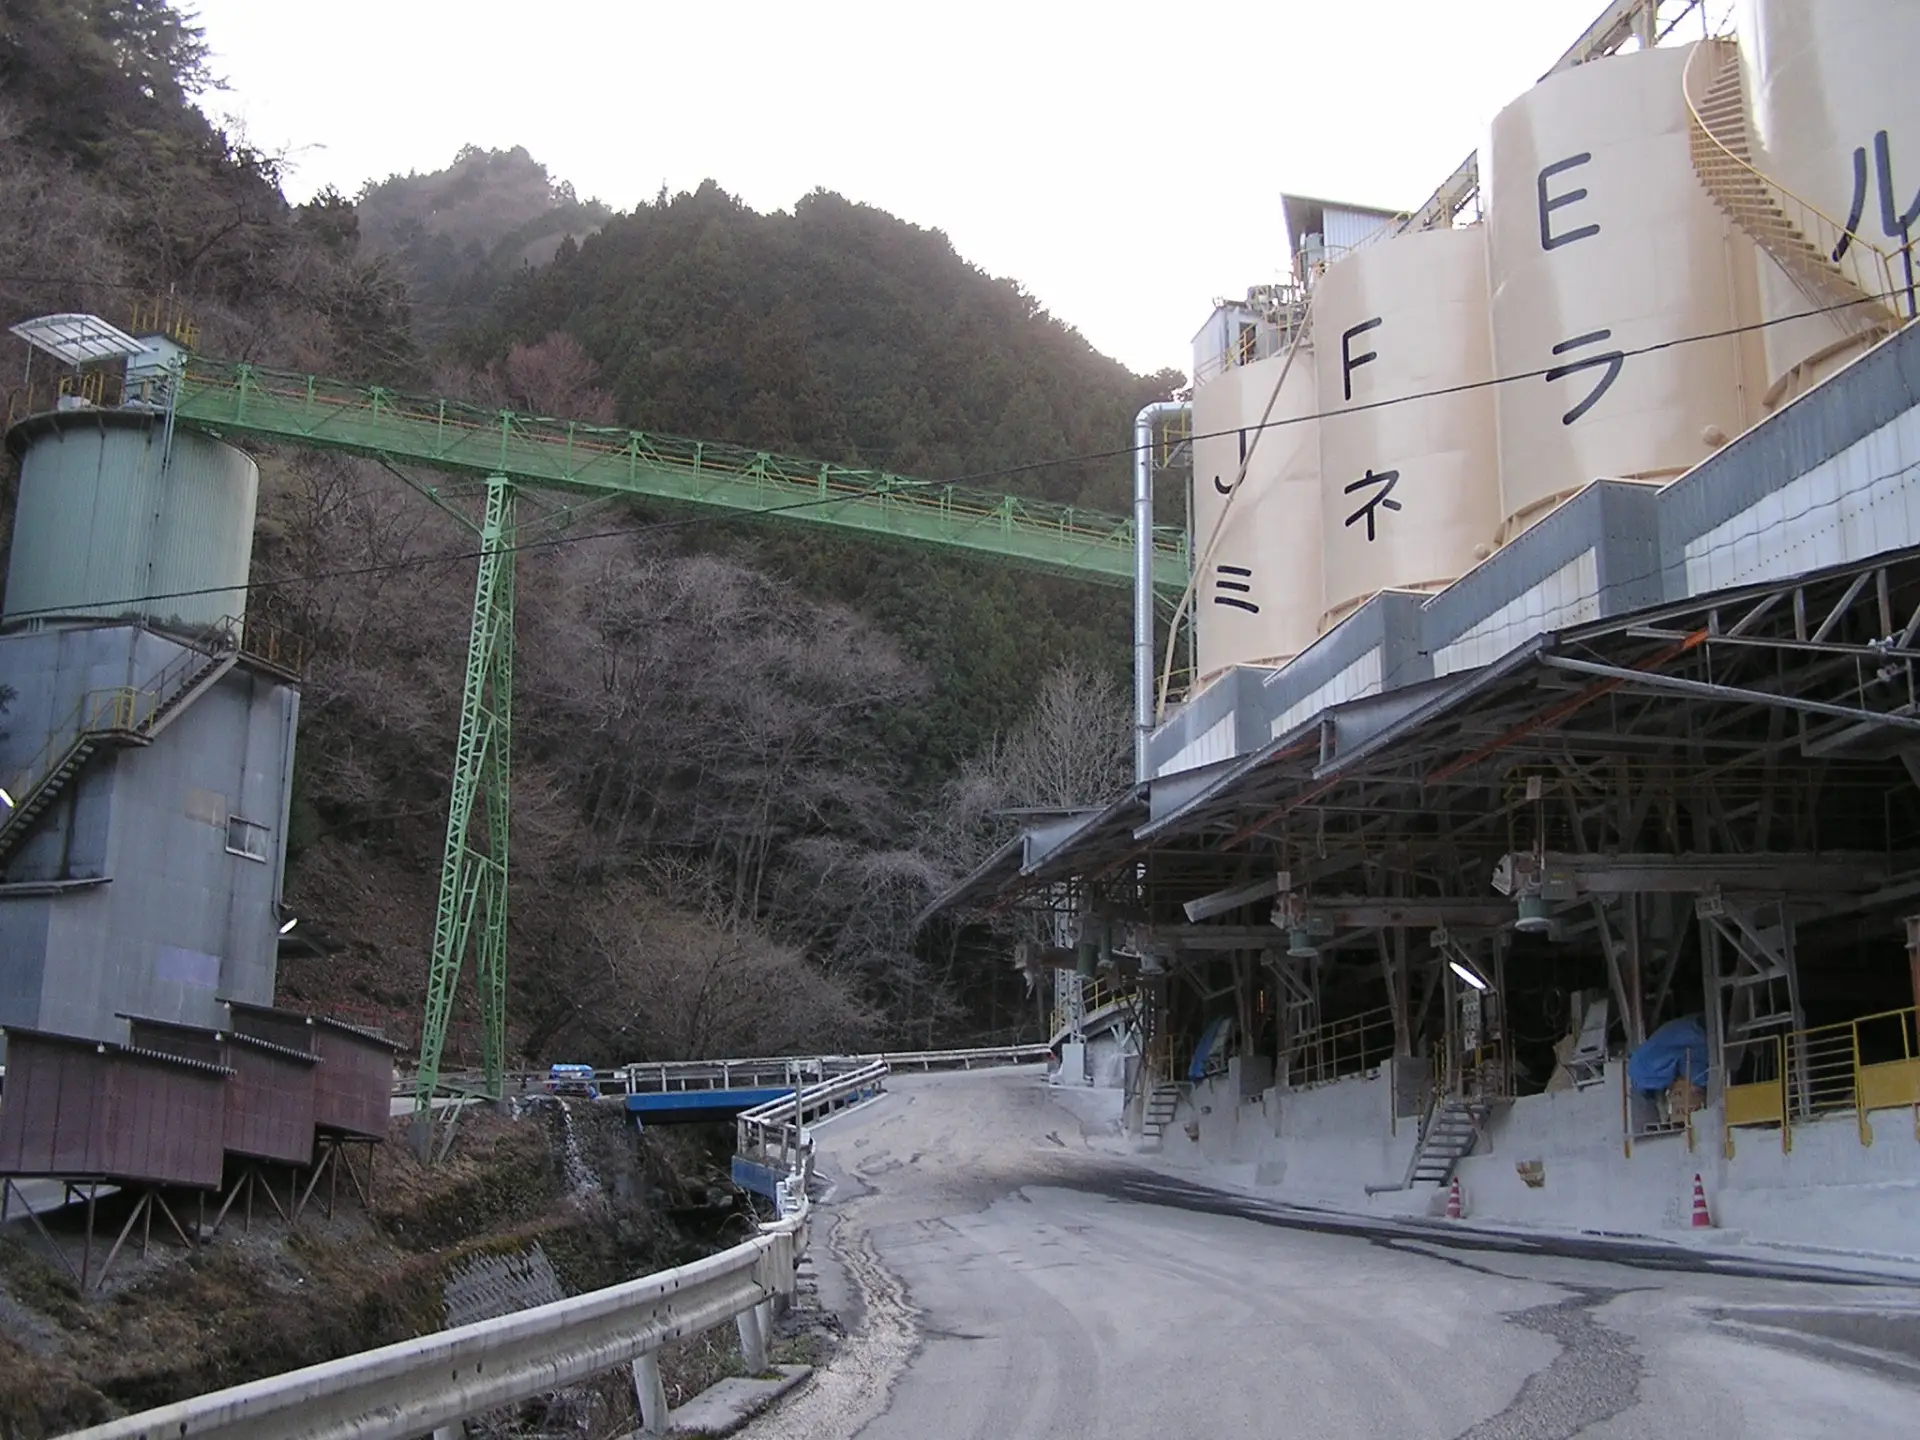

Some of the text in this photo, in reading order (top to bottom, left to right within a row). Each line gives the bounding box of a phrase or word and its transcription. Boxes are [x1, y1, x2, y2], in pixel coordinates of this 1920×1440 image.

[1343, 317, 1382, 402] F
[1538, 152, 1600, 251] E
[1344, 470, 1402, 541] ネ
[1546, 329, 1625, 425] ラ
